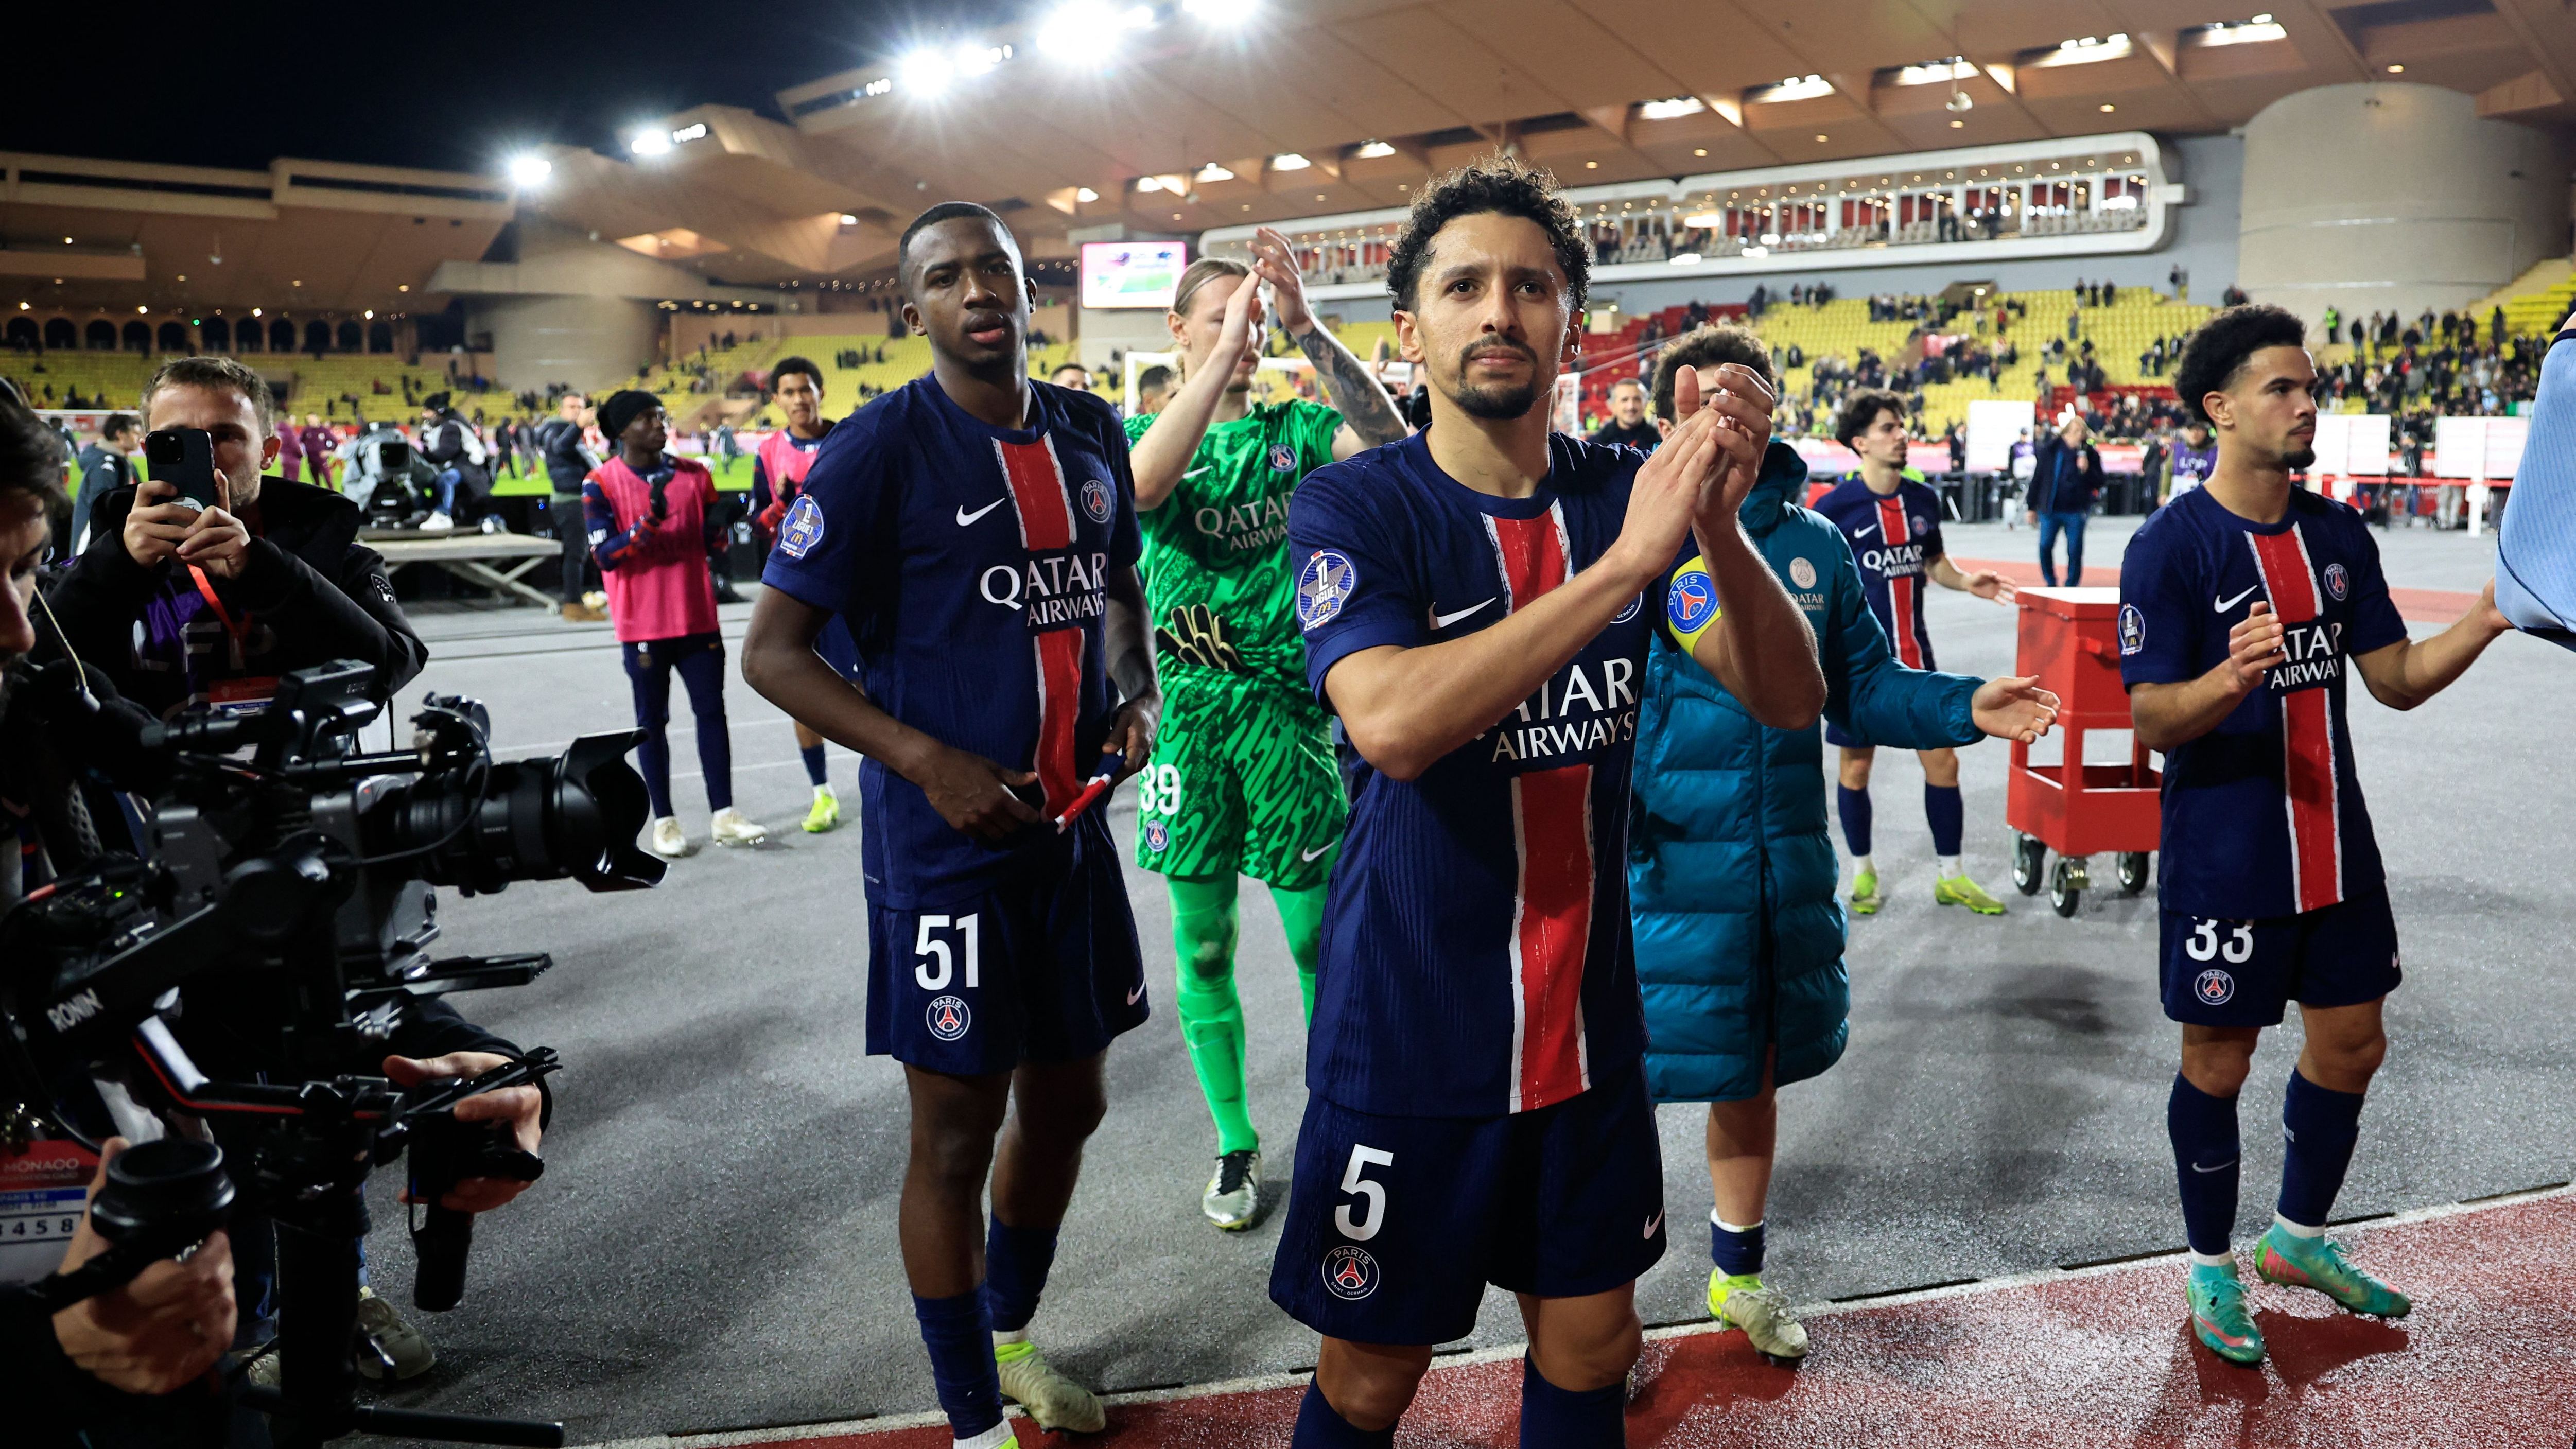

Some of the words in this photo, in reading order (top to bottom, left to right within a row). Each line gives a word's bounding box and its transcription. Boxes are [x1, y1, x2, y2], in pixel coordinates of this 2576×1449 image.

[1084, 482, 1104, 493] PARIS
[1230, 524, 1288, 551] AIRWA
[1862, 545, 1923, 571] QATAR
[980, 552, 1106, 611] QATAR
[1669, 575, 1698, 606] PARIS
[1027, 592, 1104, 627] AIRWAYS
[1617, 604, 1635, 619] GERMAIN
[1699, 597, 1714, 619] GERMAIN
[1492, 711, 1635, 762] AIRWAYS
[1140, 756, 1181, 816] 39
[915, 913, 979, 990] 51
[2186, 916, 2254, 964] 33
[2202, 971, 2228, 982] PARIS
[47, 988, 103, 1033] RONIN
[932, 998, 963, 1009] PARIS
[1335, 1143, 1394, 1241] 5
[1334, 1248, 1370, 1264] PARIS
[1331, 1281, 1344, 1294] SAINT
[1347, 1287, 1368, 1295] GERMAIN
